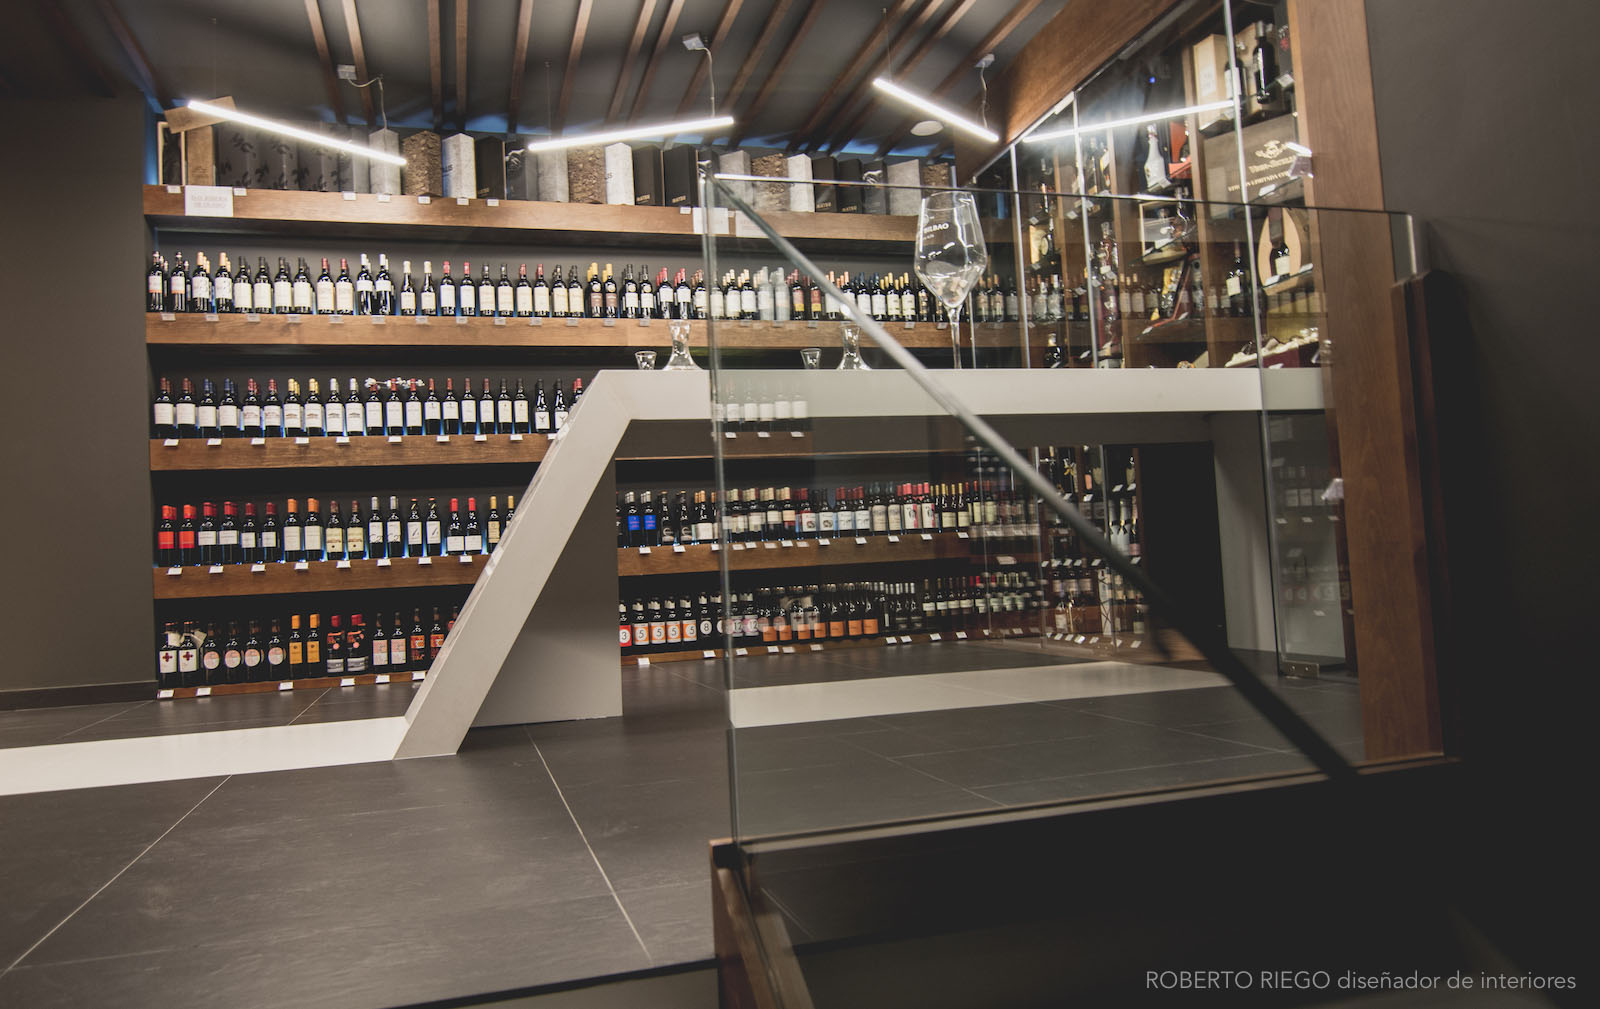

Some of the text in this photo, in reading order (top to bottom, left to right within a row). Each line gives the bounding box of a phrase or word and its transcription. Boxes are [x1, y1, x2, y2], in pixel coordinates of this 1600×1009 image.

[671, 627, 677, 637] 5
[689, 626, 695, 637] 5
[703, 623, 709, 632] 8
[621, 631, 627, 641] 3
[638, 629, 645, 639] 5
[655, 628, 662, 638] 5
